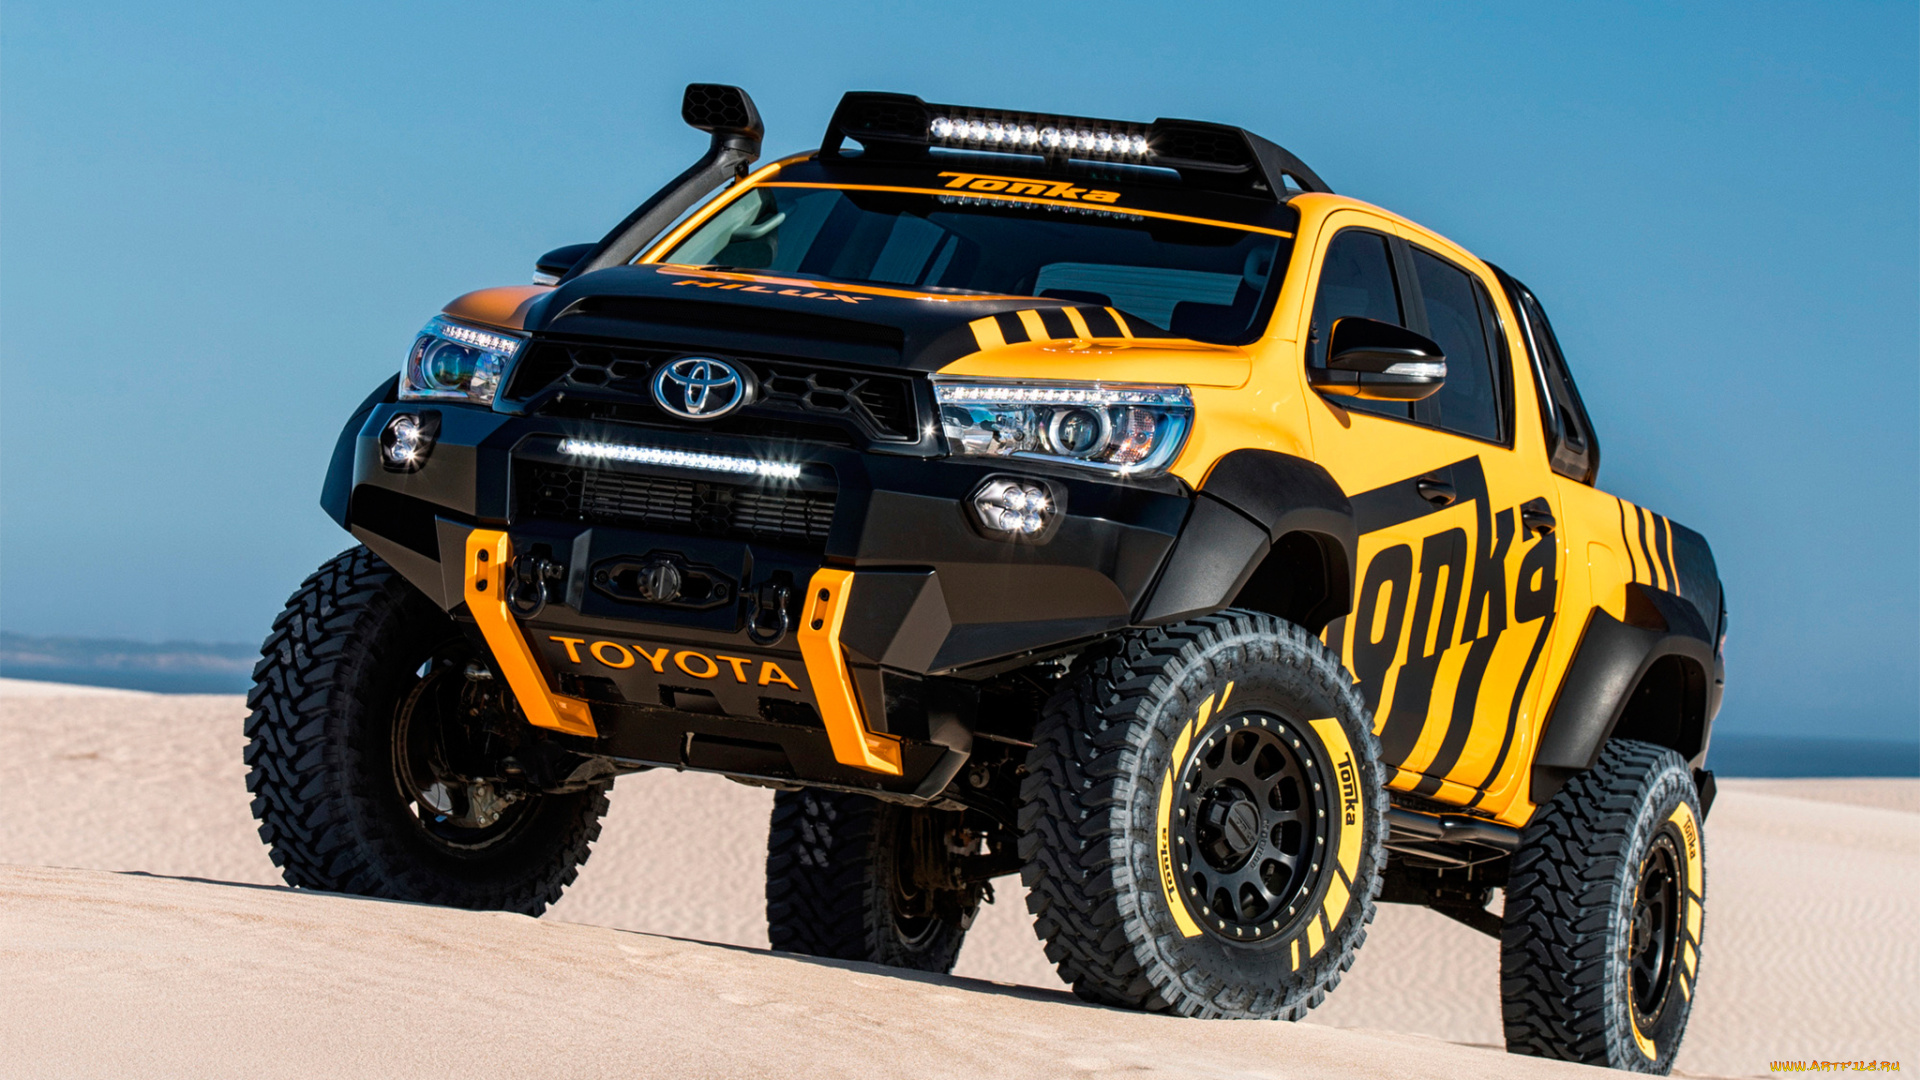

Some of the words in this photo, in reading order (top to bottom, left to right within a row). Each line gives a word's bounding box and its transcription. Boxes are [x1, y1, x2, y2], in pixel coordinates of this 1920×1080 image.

[937, 171, 1121, 204] Tonka
[672, 279, 874, 304] HILUX
[548, 635, 801, 692] TOYOTA
[1337, 751, 1359, 826] Tonka
[1683, 813, 1697, 861] Tonka
